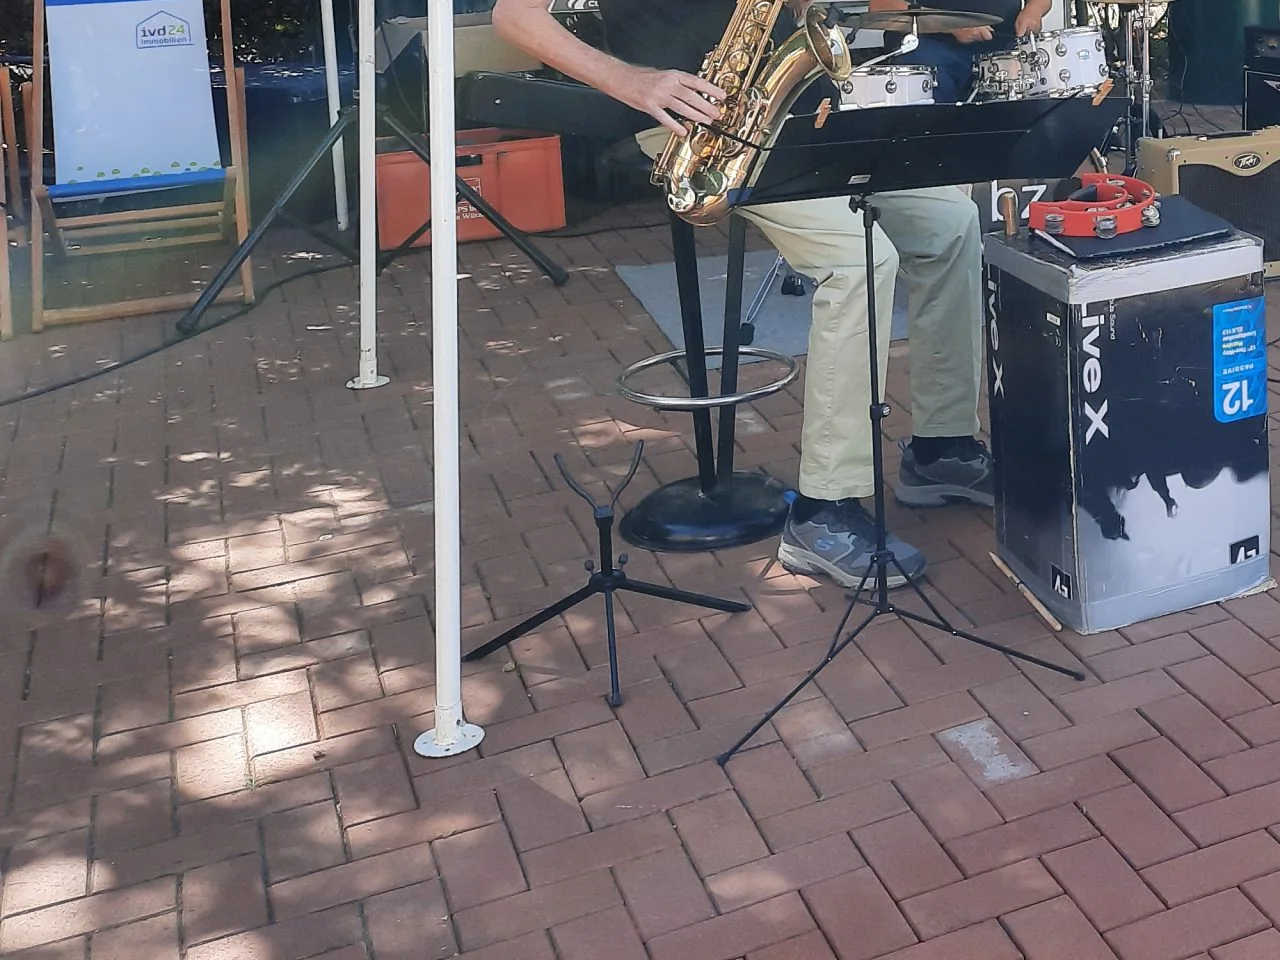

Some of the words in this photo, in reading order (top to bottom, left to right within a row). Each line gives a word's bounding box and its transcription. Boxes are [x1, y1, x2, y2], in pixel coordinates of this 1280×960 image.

[141, 24, 185, 37] ivd24
[991, 355, 1005, 400] X
[1222, 363, 1254, 375] PASSIVE
[1222, 379, 1254, 415] 12
[1084, 398, 1109, 446] X
